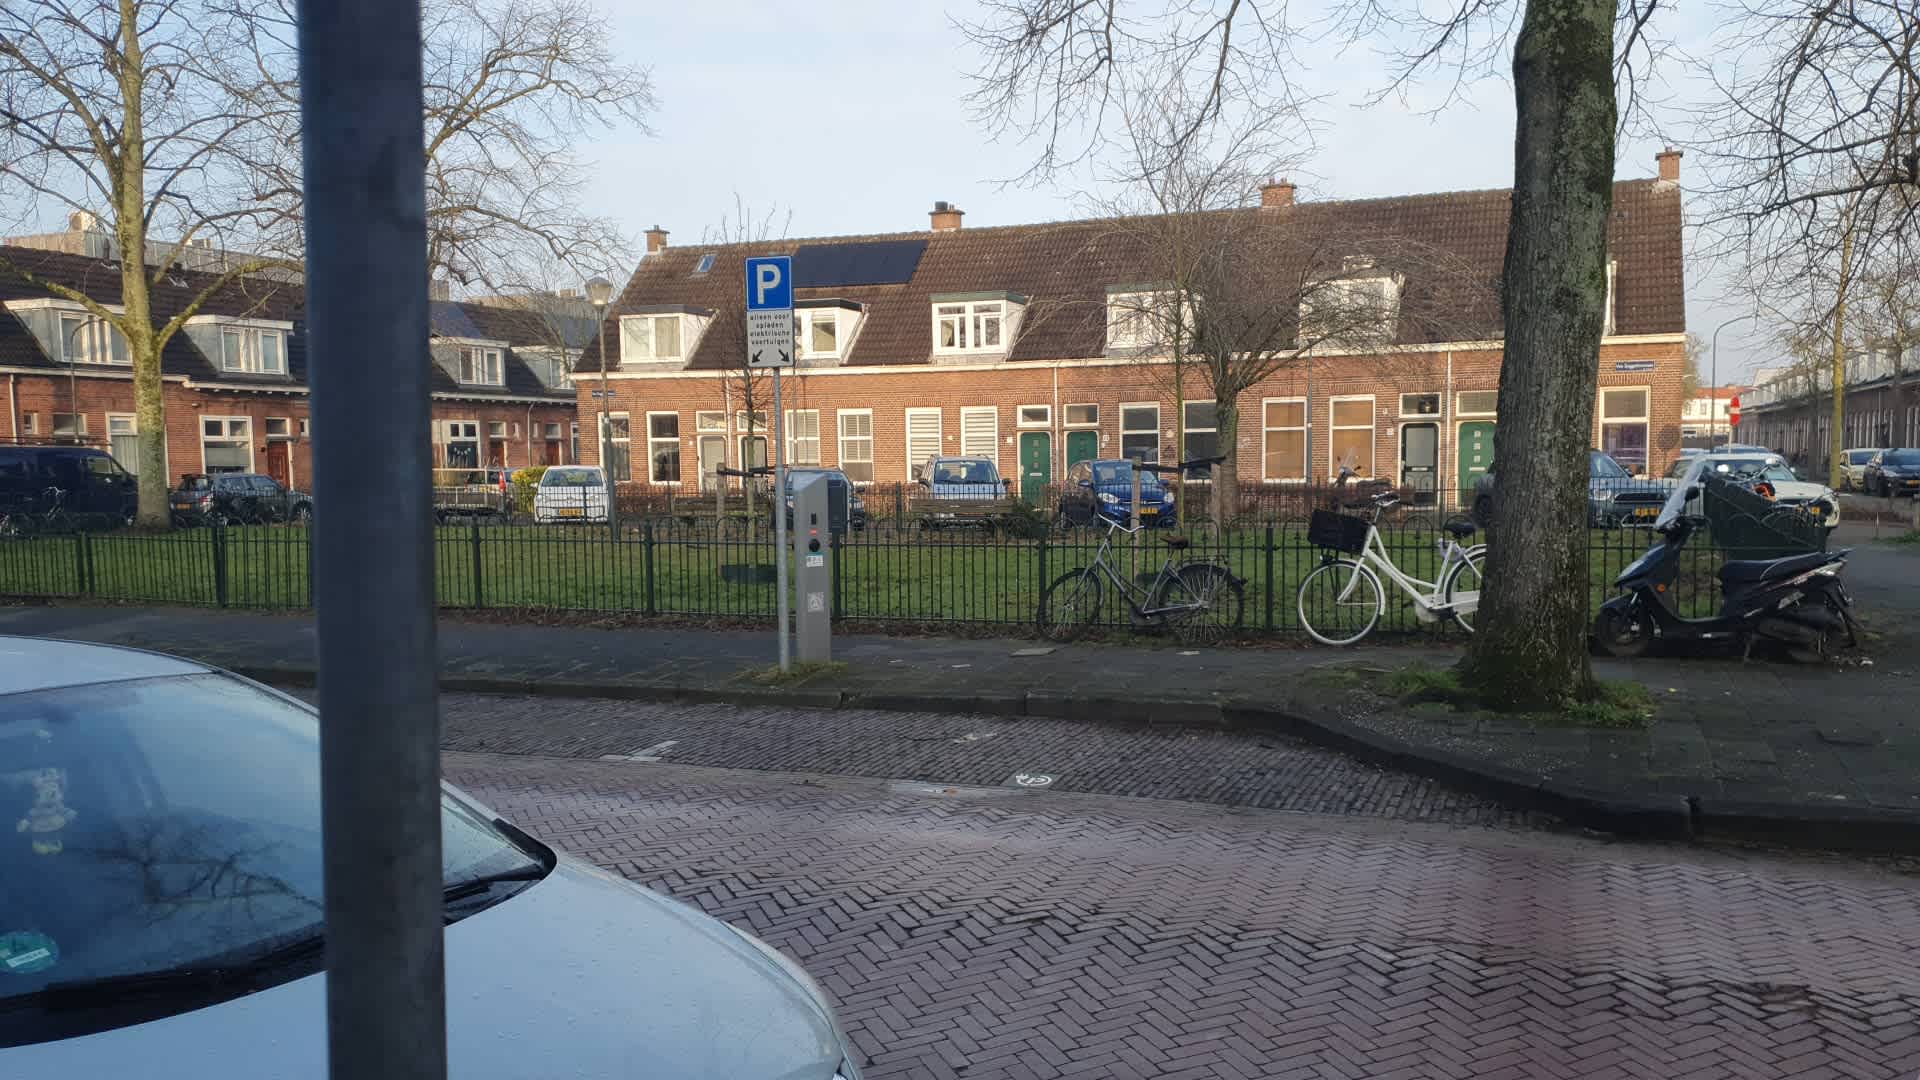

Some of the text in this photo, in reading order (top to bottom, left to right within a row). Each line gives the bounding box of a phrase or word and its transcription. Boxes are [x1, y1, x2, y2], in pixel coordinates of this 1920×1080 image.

[757, 264, 781, 304] P
[756, 321, 784, 329] opladen
[751, 338, 790, 346] voertuigen
